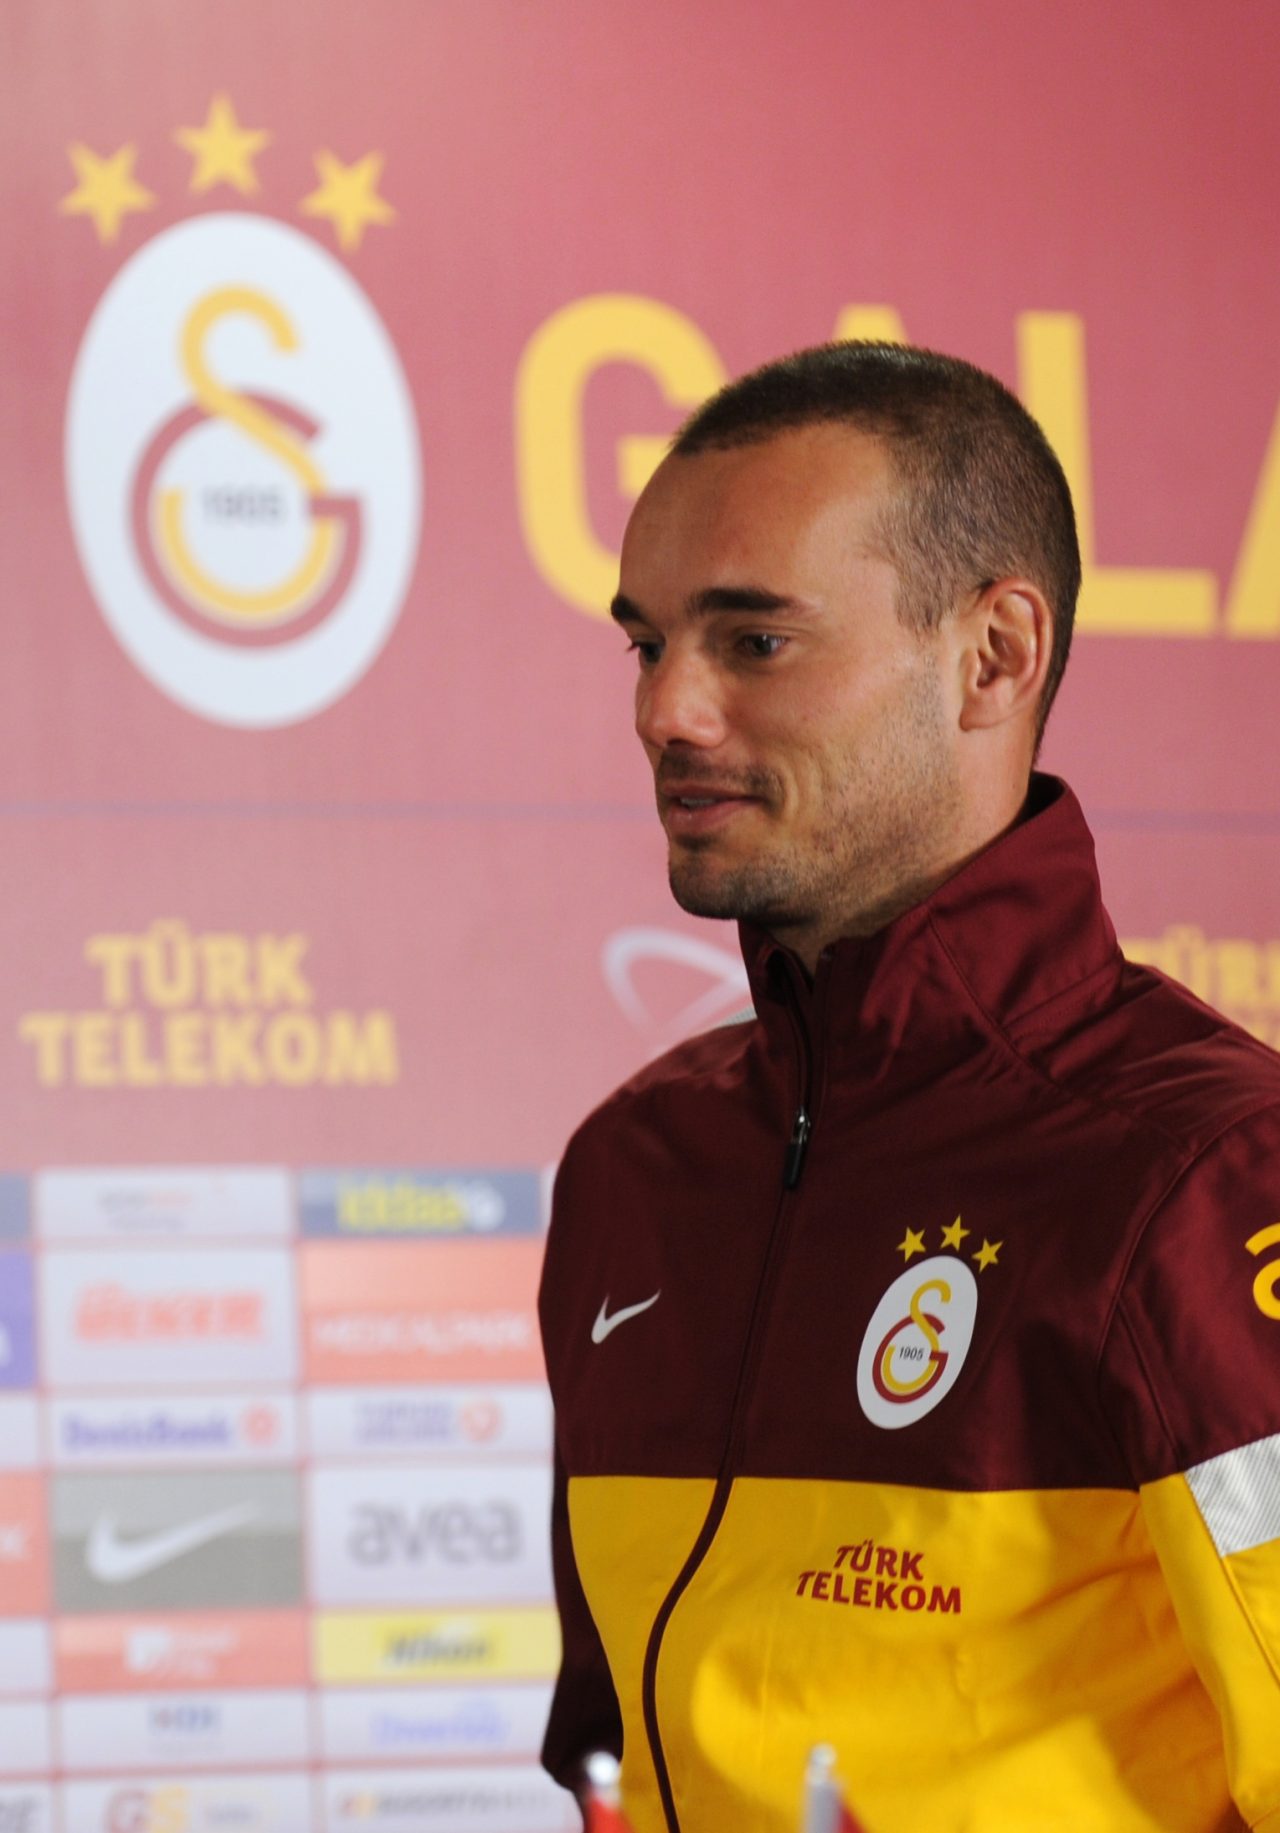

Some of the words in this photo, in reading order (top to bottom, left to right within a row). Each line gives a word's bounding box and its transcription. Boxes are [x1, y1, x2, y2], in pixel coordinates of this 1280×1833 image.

[86, 919, 313, 1008] TÜRK
[20, 1009, 398, 1087] TELEKOM
[900, 1346, 924, 1362] 1905
[347, 1499, 524, 1569] avea
[834, 1539, 924, 1582] TÜRK
[796, 1570, 962, 1615] TELEKOM
